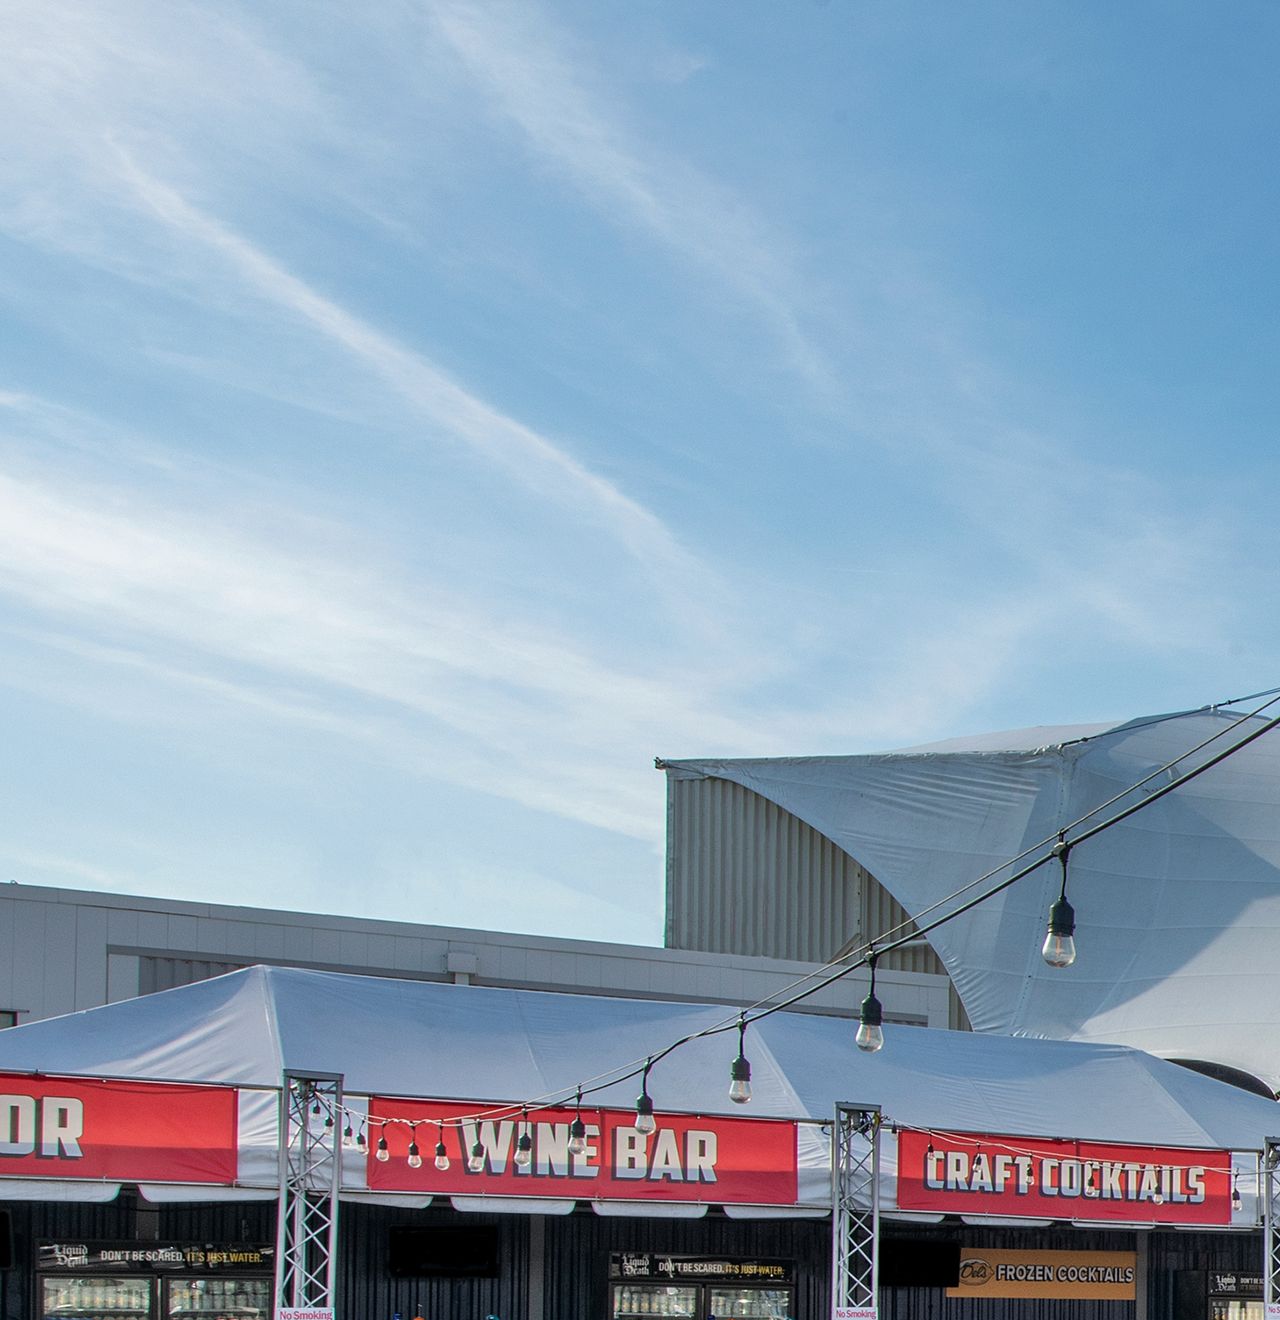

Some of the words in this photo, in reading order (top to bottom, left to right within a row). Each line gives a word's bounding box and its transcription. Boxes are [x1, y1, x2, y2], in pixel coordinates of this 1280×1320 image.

[461, 1118, 601, 1178] WINE
[611, 1126, 718, 1183] BAR
[924, 1151, 1033, 1196] CRAFT
[1040, 1157, 1206, 1204] COCKTAILS
[100, 1250, 130, 1262] DON'T
[132, 1251, 145, 1262] BE
[145, 1251, 186, 1263] SCARED.
[187, 1251, 205, 1263] IT'S
[229, 1252, 263, 1264] WATER.
[658, 1261, 682, 1273] DON'T
[683, 1263, 693, 1273] BE
[996, 1264, 1054, 1282] FROZEN
[1056, 1266, 1135, 1283] COCKTAILS
[279, 1311, 293, 1320] No
[836, 1310, 846, 1318] No
[846, 1310, 877, 1320] Smoking
